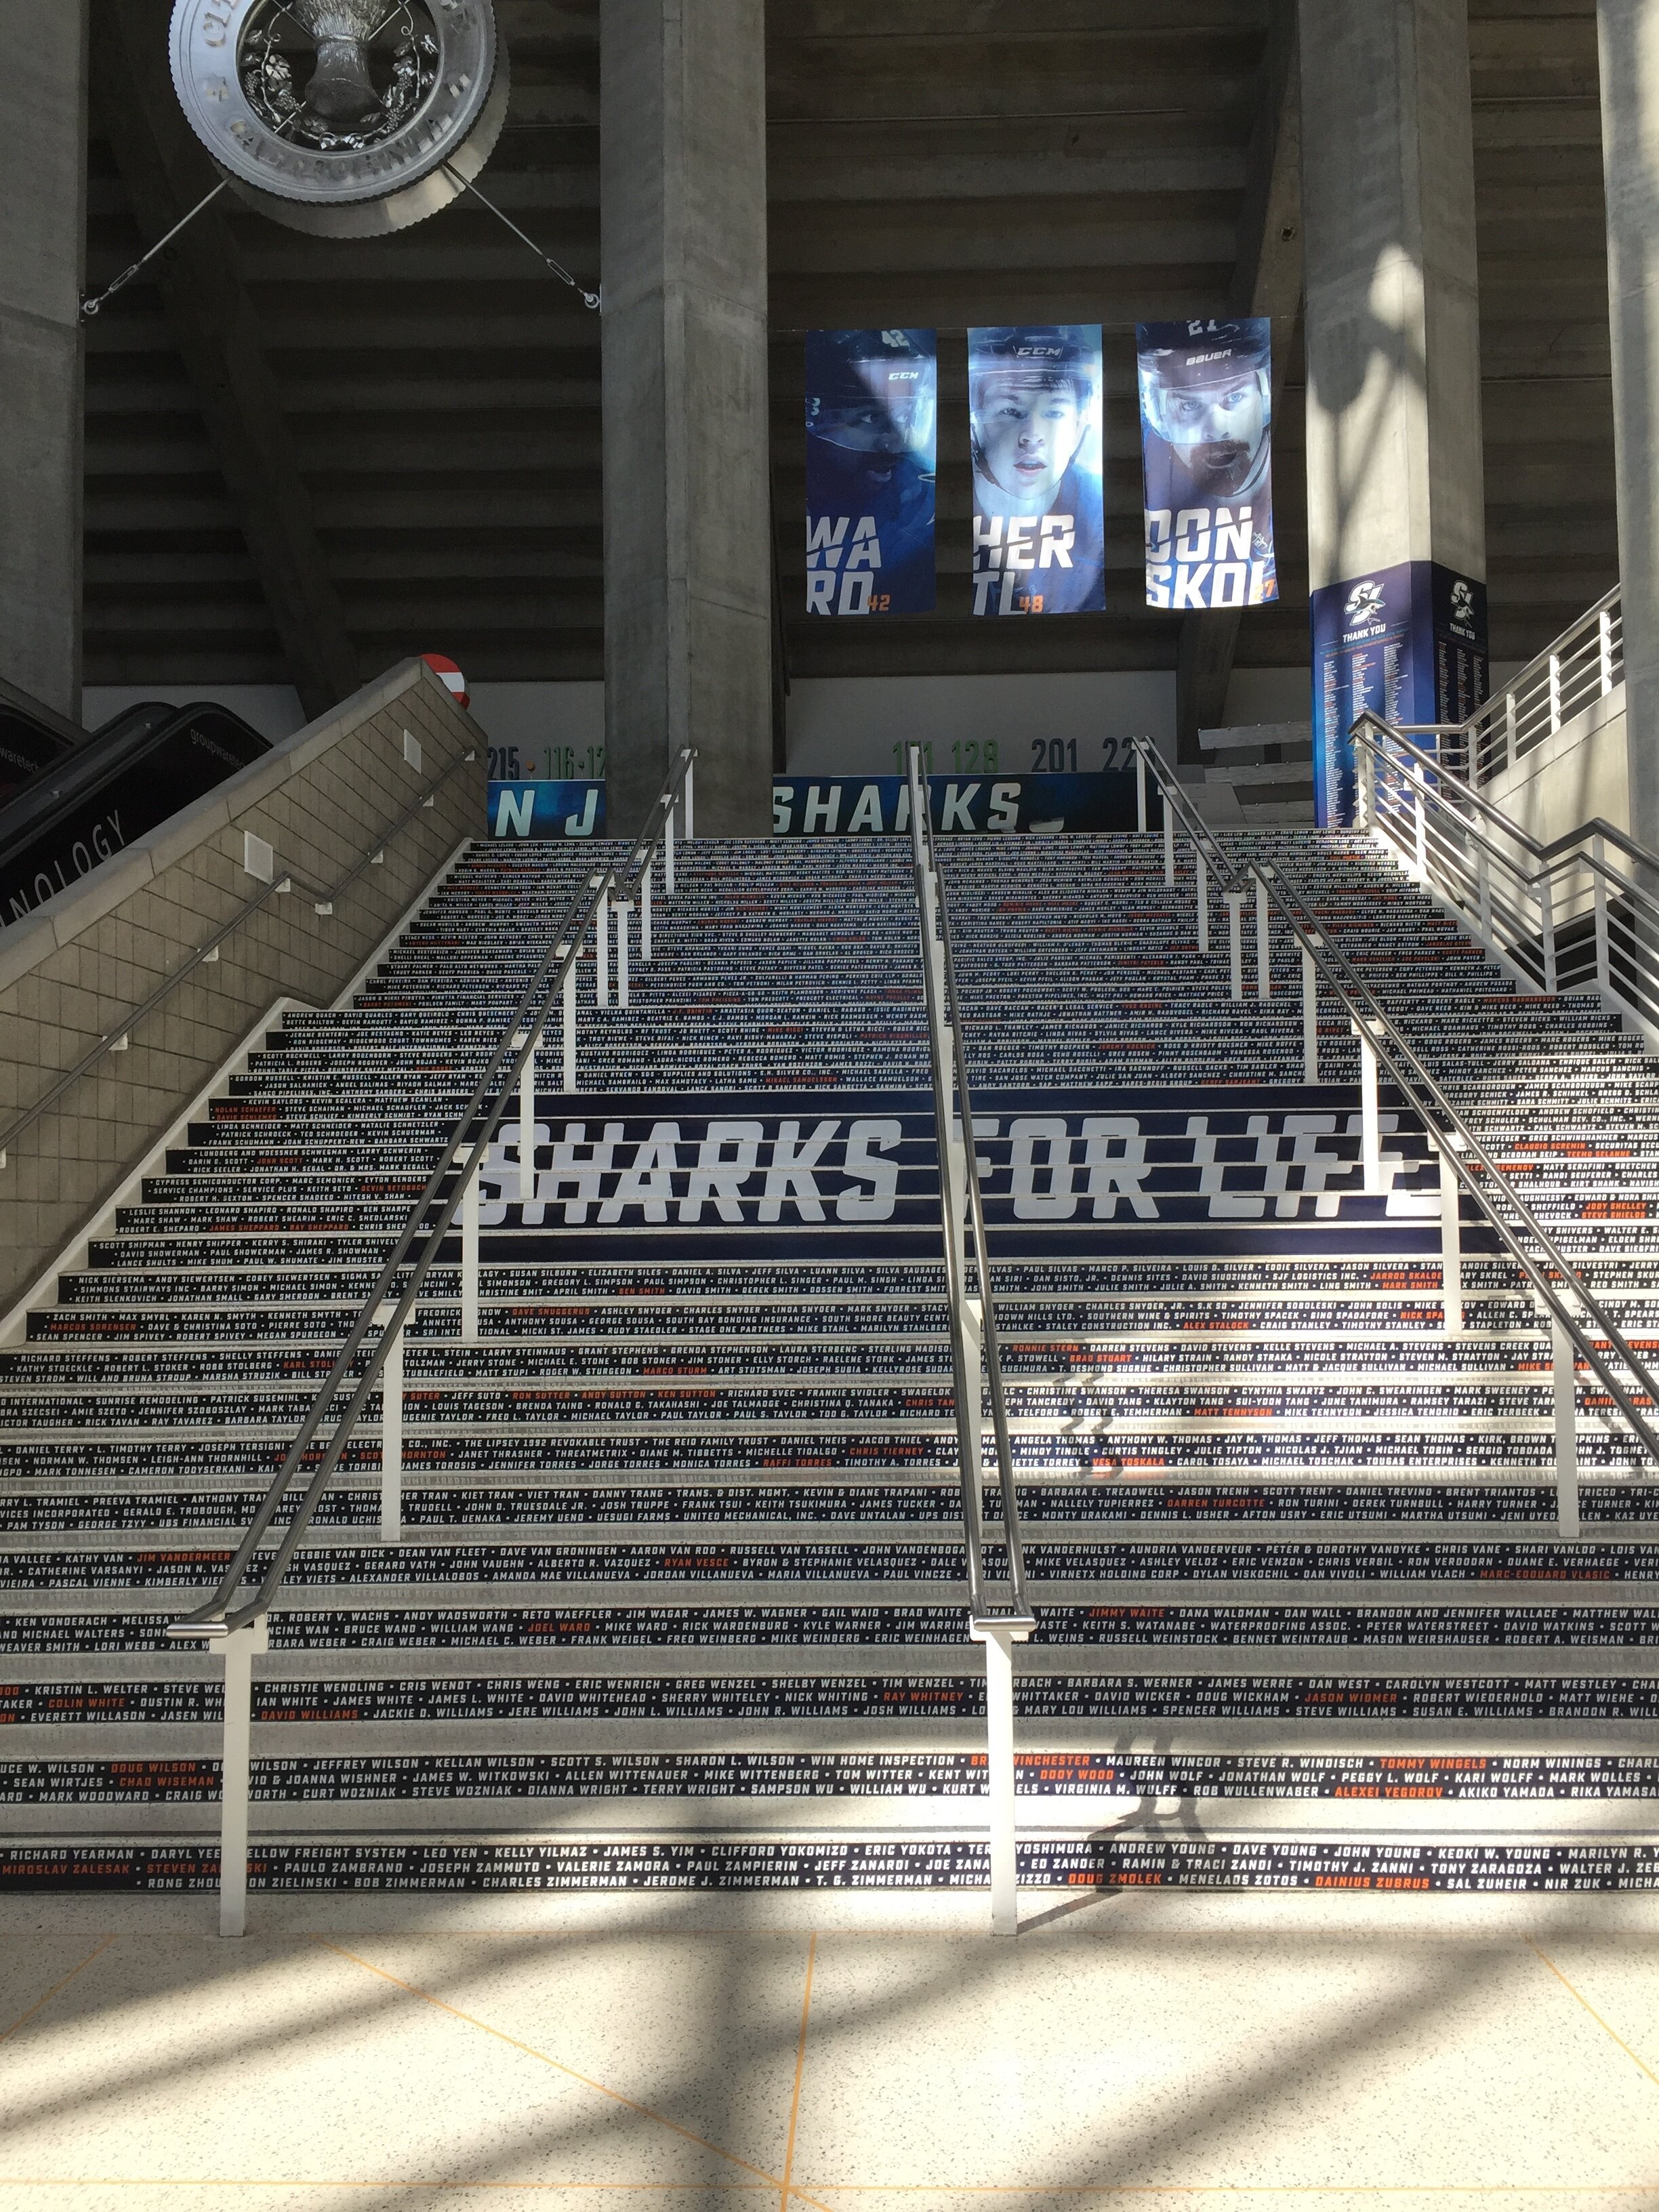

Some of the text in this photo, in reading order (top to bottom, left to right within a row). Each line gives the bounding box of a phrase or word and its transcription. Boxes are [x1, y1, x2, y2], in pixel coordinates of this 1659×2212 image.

[1018, 347, 1061, 356] CCM
[888, 371, 919, 380] CCM
[806, 516, 881, 569] WA
[973, 515, 1076, 570] HER
[806, 570, 874, 615] RD
[973, 571, 1027, 615] TL
[867, 594, 890, 611] 42
[1019, 595, 1044, 613] 48
[1343, 623, 1386, 643] THANK YOU
[1450, 623, 1475, 640] THANK YOU
[951, 739, 998, 774] 128
[1031, 738, 1078, 773] 201
[495, 790, 535, 836] N
[565, 789, 599, 836] J
[451, 1114, 1442, 1225] SHARKS FOR LIFE
[1096, 1354, 1132, 1362] STUART
[1178, 1353, 1212, 1361] STRAIN
[139, 1396, 198, 1404] REMODELING
[581, 1391, 607, 1399] ANDY
[1193, 1408, 1272, 1416] MATT TENNYSON
[1091, 1458, 1164, 1467] VESA TOSKALA
[664, 1558, 729, 1566] RYAN VESCE
[527, 1622, 668, 1632] JOEL WARD MIKE WARD
[1503, 1622, 1594, 1631] DAVID WATKINS
[35, 1684, 199, 1695] KRISTIN L. WELTER STEVE
[487, 1679, 660, 1689] CHRIS WENG ERIC WENRICH
[883, 1692, 963, 1701] RAY WHITNEY
[1304, 1692, 1543, 1702] JASON WIDMER ROBERT WIEDERHOLD
[48, 1698, 125, 1708] COLIN WHITE
[260, 1709, 358, 1720] DAVID WILLIAMS
[110, 1762, 195, 1773] DOUG WILSON
[435, 1757, 534, 1767] KELLAN WILSON
[1380, 1757, 1601, 1769] TOMMY WINGELS NORM WININGS
[1040, 1769, 1203, 1781] DODY WOOD JOHN WOLF
[13, 1776, 213, 1787] SEAN WIRTJES CHAD WISEMAN
[1054, 1783, 1177, 1795] VIRGINIA M. WULFF
[1334, 1786, 1554, 1797] ALEXEI YEGOROV AKIKO YAMADA
[39, 1790, 202, 1801] MARK WOODWARD CRAIG
[9, 1849, 192, 1860] RICHARD YEARMAN DARYL
[423, 1846, 587, 1858] LEO YEN KELLY YILMAZ
[1232, 1844, 1420, 1858] DAVE YOUNG JOHN YOUNG
[2, 1863, 195, 1874] MIROSLAV ZALESAK STEVEN
[1031, 1858, 1105, 1868] ED ZANDER
[482, 1875, 799, 1887] CHARLES ZIMMERMAN JEROME J. ZIMMERMAN
[1068, 1873, 1162, 1883] DOUG ZMOLEK
[1315, 1876, 1526, 1889] DAINIUS ZUBRUS SAL ZUHEIR
